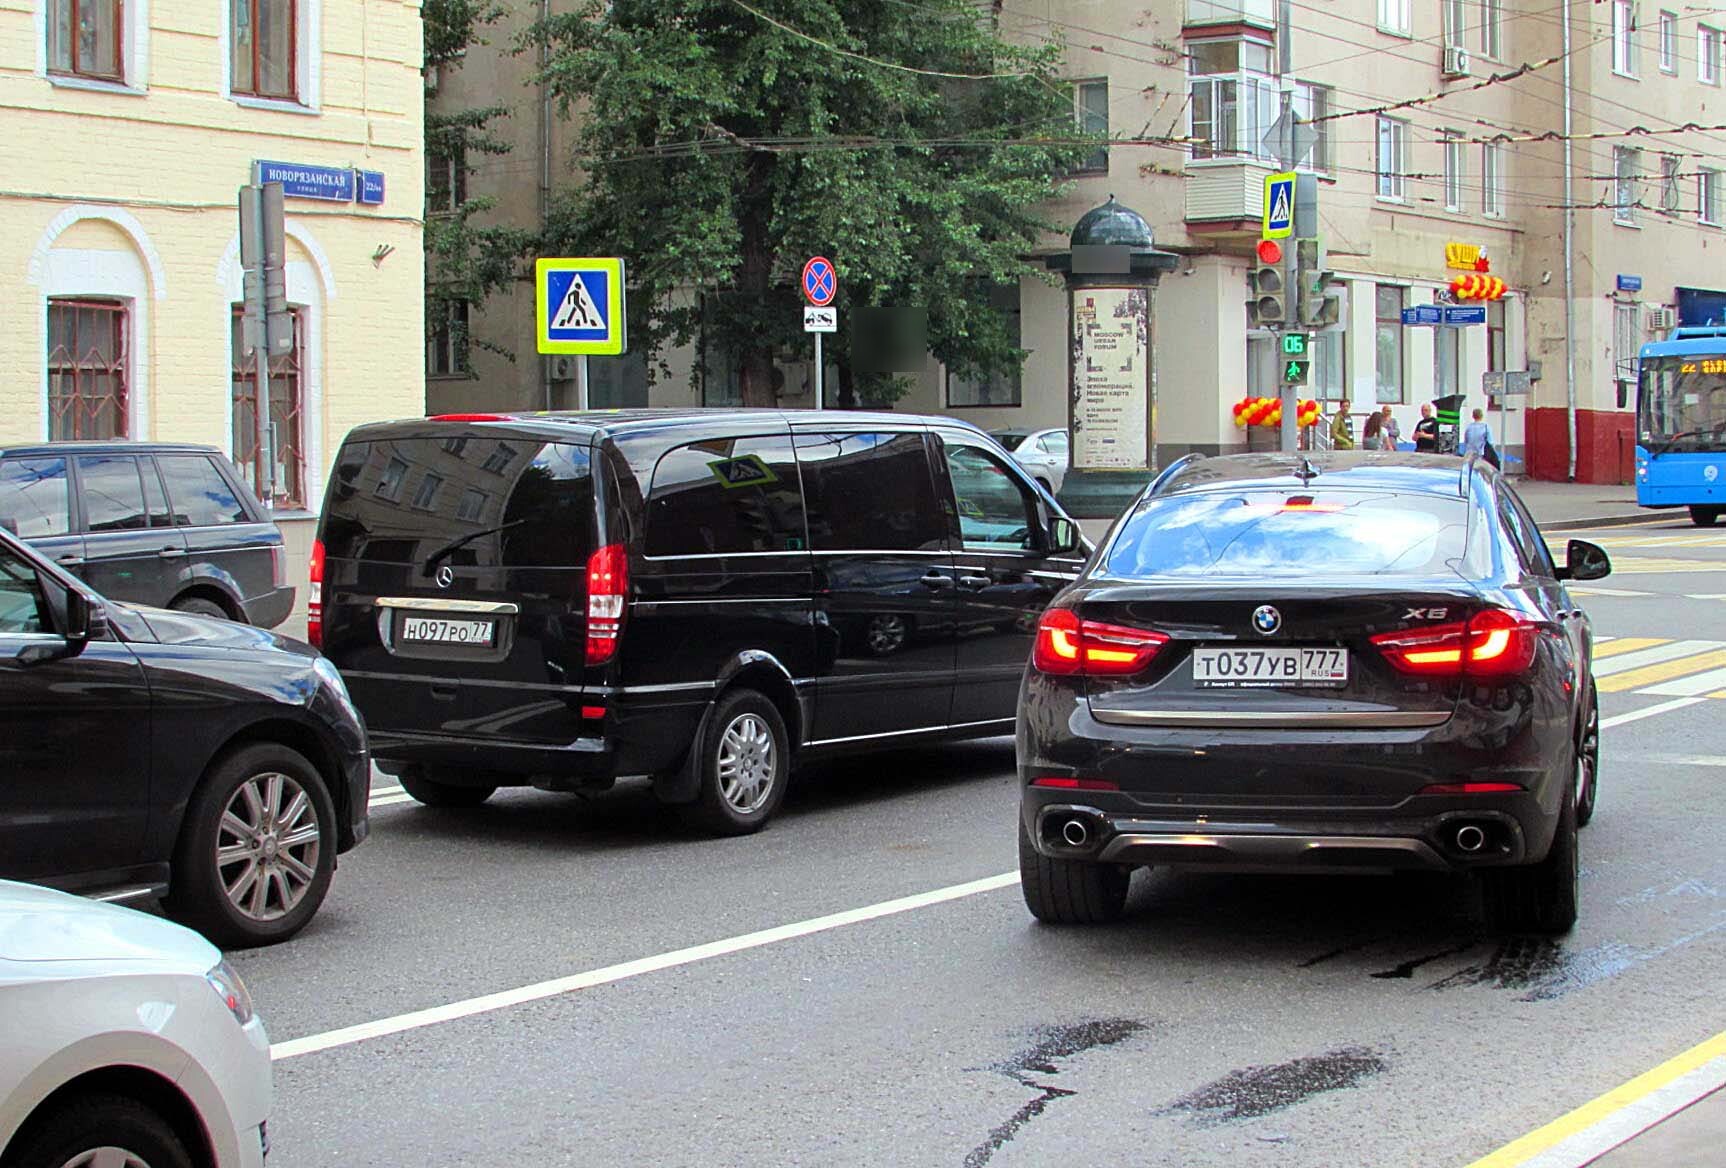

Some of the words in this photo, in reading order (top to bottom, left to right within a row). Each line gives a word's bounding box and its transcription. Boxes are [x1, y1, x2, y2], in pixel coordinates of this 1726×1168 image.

[269, 169, 345, 187] НОВОРЯЗАНСКАЯ
[1284, 335, 1304, 353] 06
[1401, 608, 1448, 620] X6
[473, 622, 489, 637] 77
[1201, 652, 1297, 676] Т037УВ
[1303, 650, 1340, 669] 777
